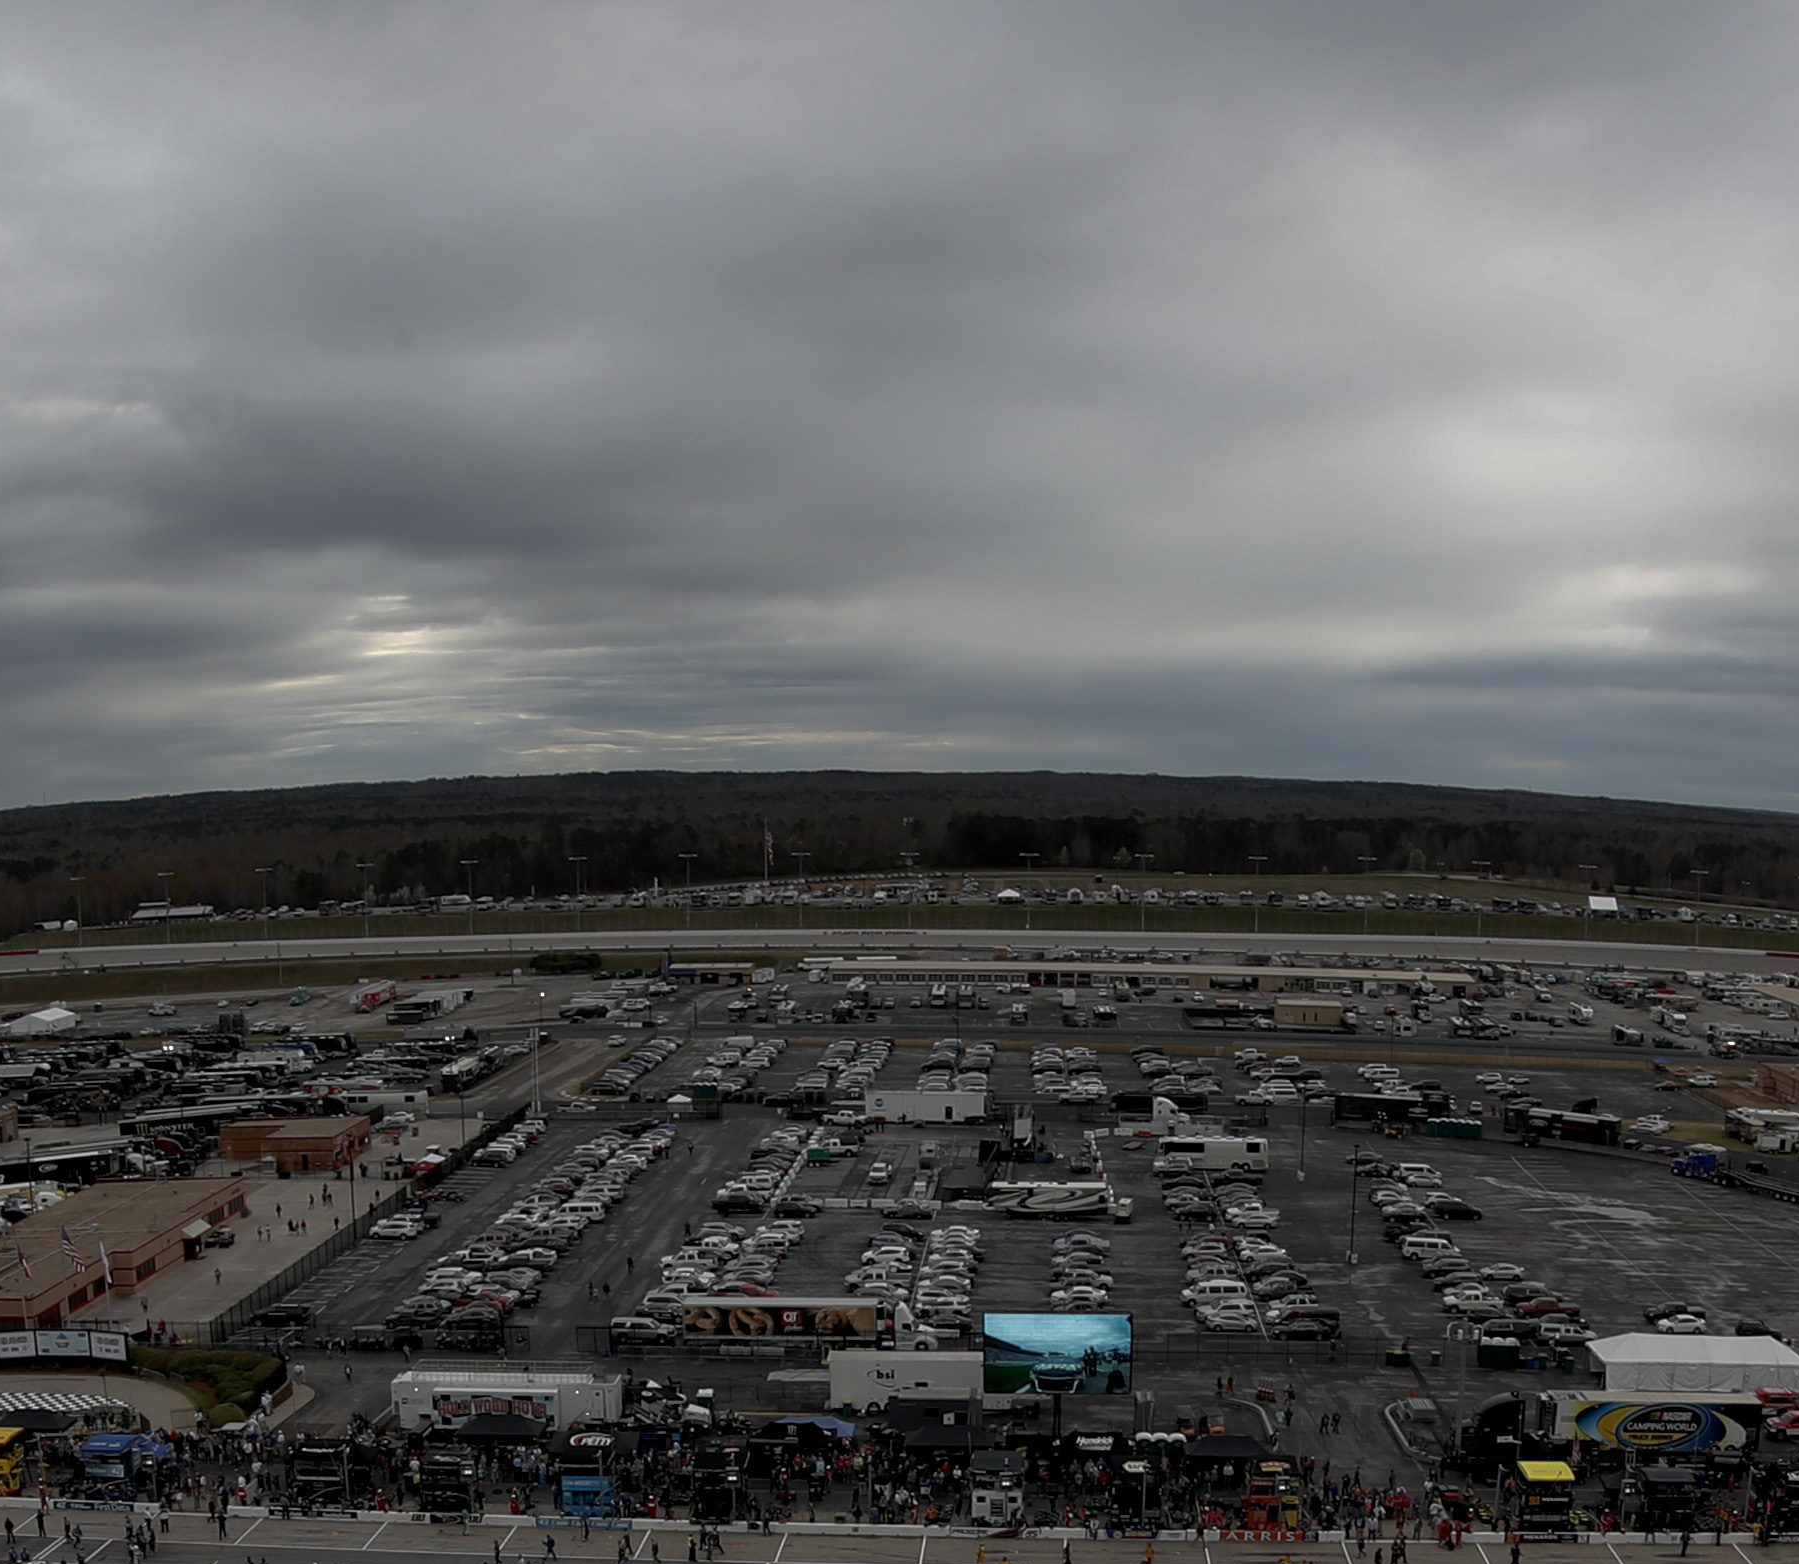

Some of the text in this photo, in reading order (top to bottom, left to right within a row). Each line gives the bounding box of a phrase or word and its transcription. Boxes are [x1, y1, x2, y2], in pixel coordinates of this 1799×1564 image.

[783, 1311, 799, 1322] QT
[876, 1369, 895, 1379] bsi
[1626, 1421, 1698, 1432] CAMPING WORLD
[1075, 1435, 1115, 1447] Hendrick
[111, 1503, 132, 1512] Data
[1225, 1530, 1296, 1542] ARRIS
